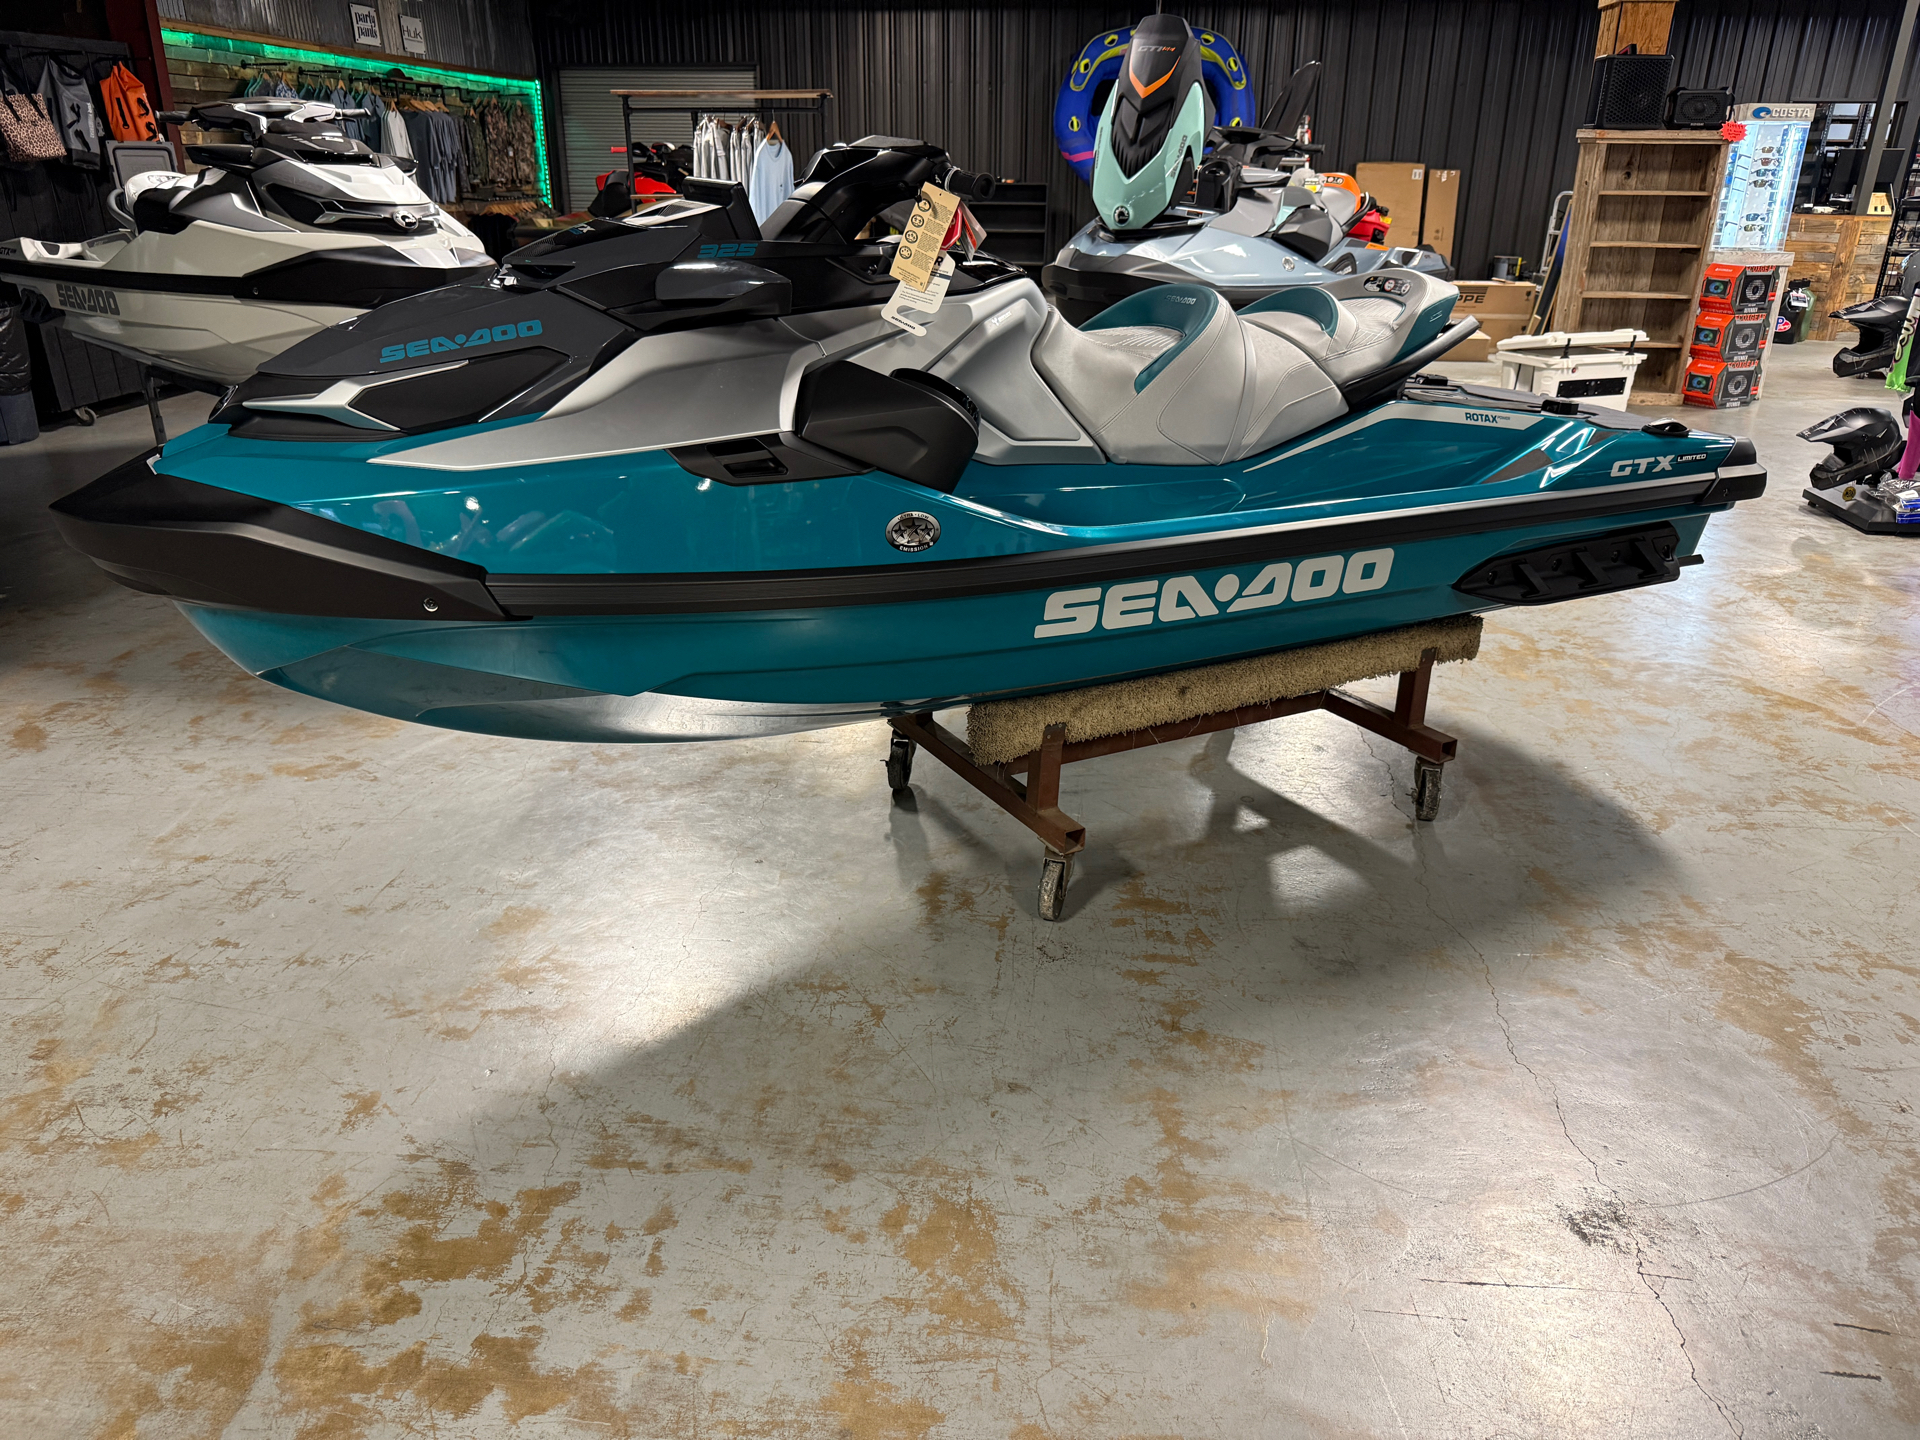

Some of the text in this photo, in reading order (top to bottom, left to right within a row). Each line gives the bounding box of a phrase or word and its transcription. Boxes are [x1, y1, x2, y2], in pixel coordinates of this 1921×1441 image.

[355, 11, 376, 27] party
[357, 24, 378, 39] pants
[1771, 107, 1811, 118] COSTA
[697, 243, 758, 258] 325
[1465, 412, 1498, 424] ROTAX
[1610, 453, 1707, 477] GTX LIMITED
